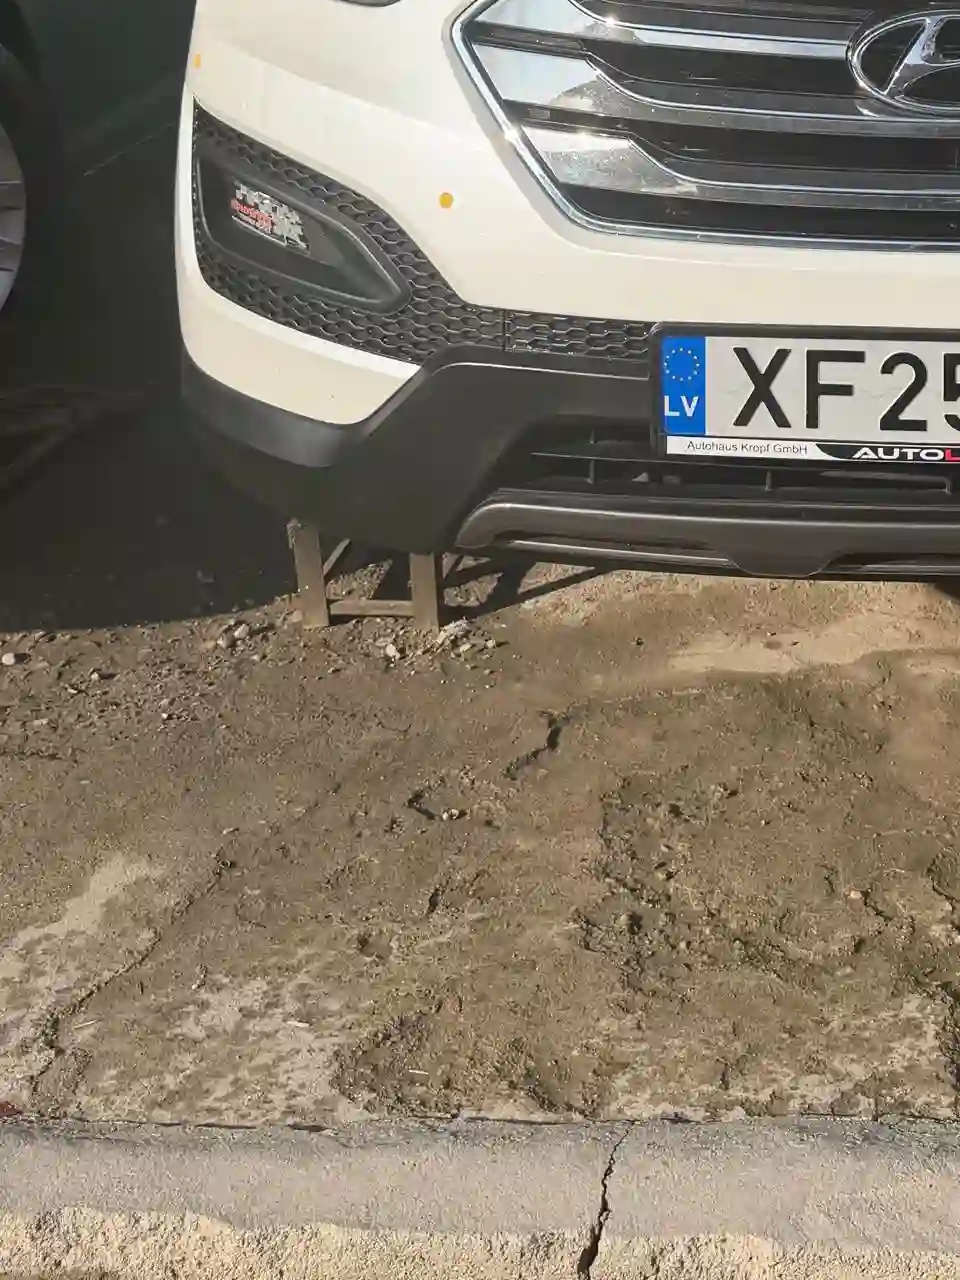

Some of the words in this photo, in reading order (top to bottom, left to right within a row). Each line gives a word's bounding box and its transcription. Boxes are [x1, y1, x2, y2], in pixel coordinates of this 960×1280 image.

[664, 396, 699, 418] LV
[687, 440, 738, 452] Autohaus
[741, 442, 769, 455] Kropf
[773, 443, 807, 455] GmbH
